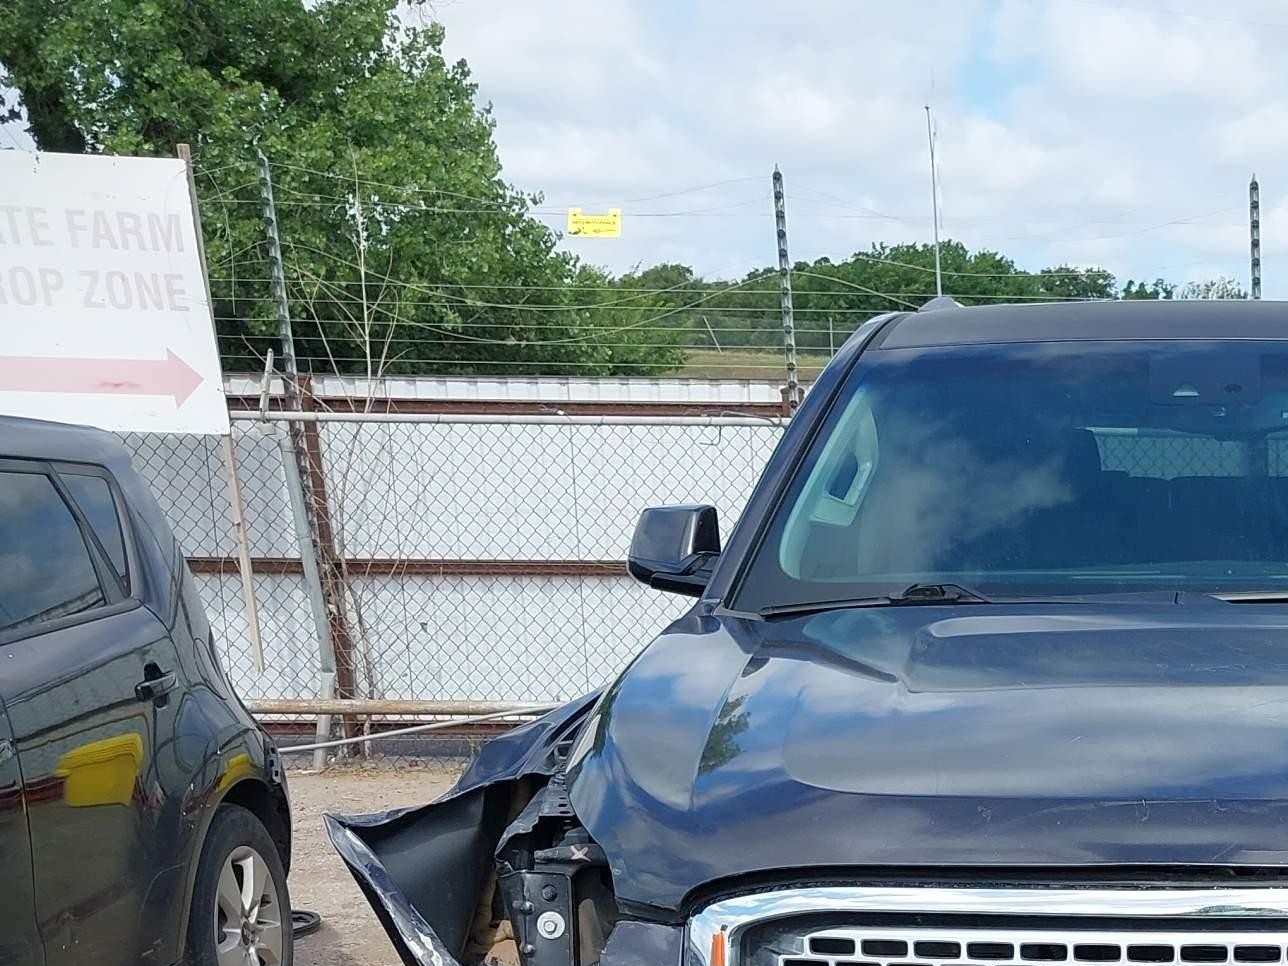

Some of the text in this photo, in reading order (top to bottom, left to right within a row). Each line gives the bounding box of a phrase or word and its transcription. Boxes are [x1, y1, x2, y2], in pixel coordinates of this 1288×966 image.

[0, 204, 185, 253] TE FARM
[79, 269, 190, 313] ZONE
